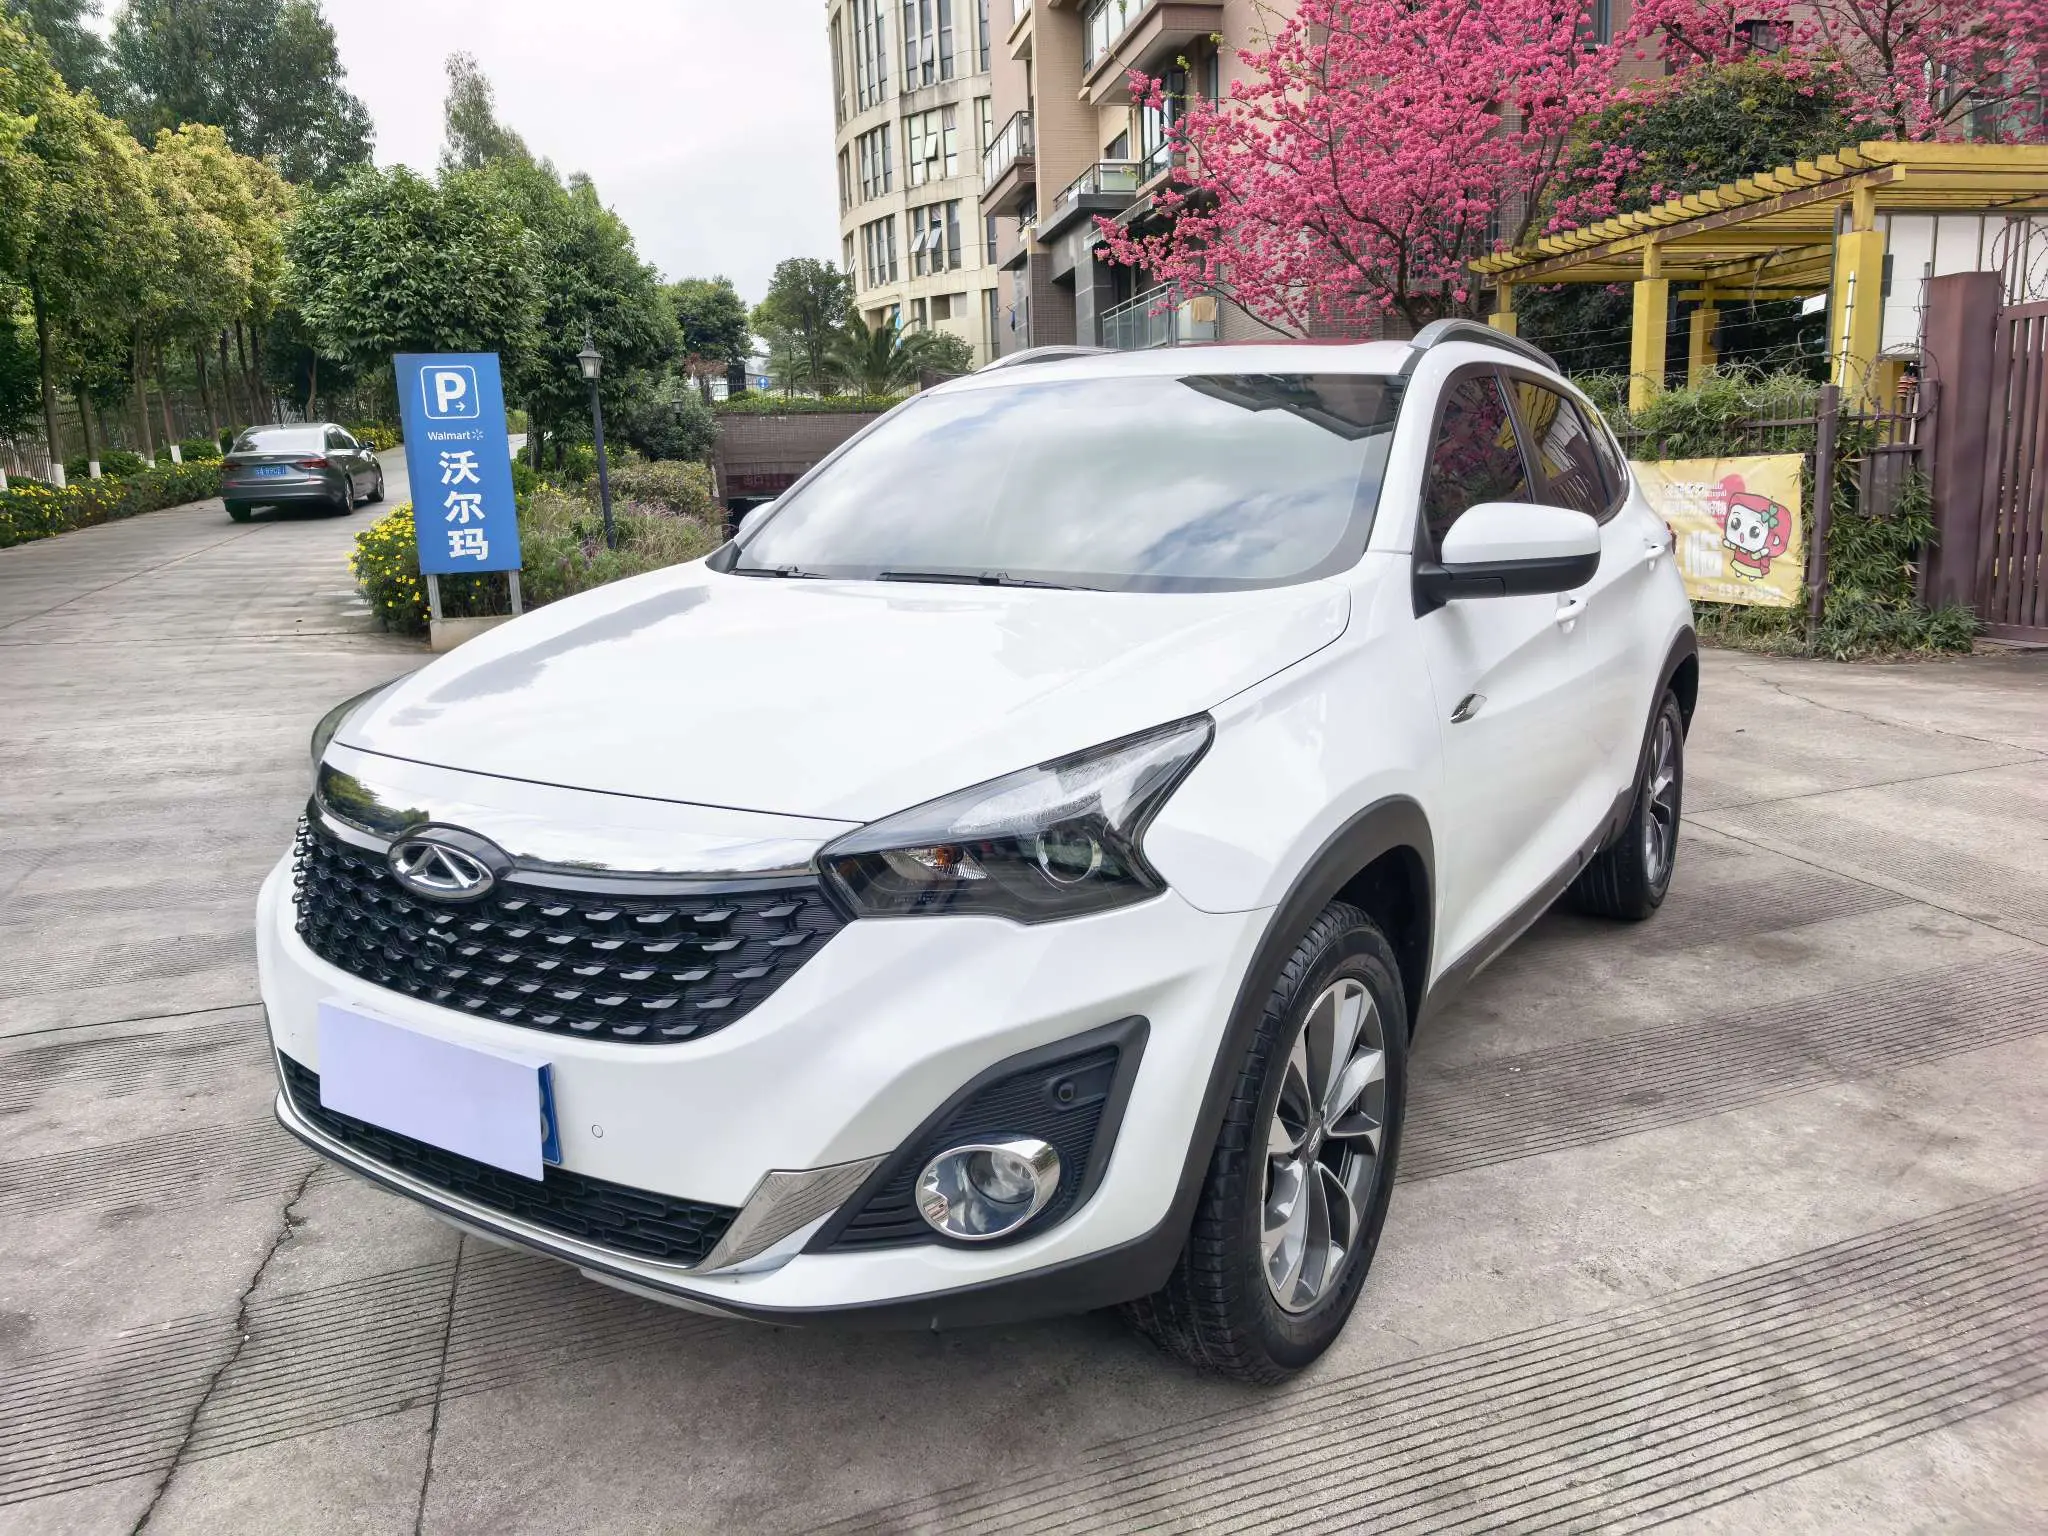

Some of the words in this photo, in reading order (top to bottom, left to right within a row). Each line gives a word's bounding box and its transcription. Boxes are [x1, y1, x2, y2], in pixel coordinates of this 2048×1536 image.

[434, 371, 467, 413] P
[427, 430, 471, 441] Walmart
[438, 449, 489, 561] 沃尔玛
